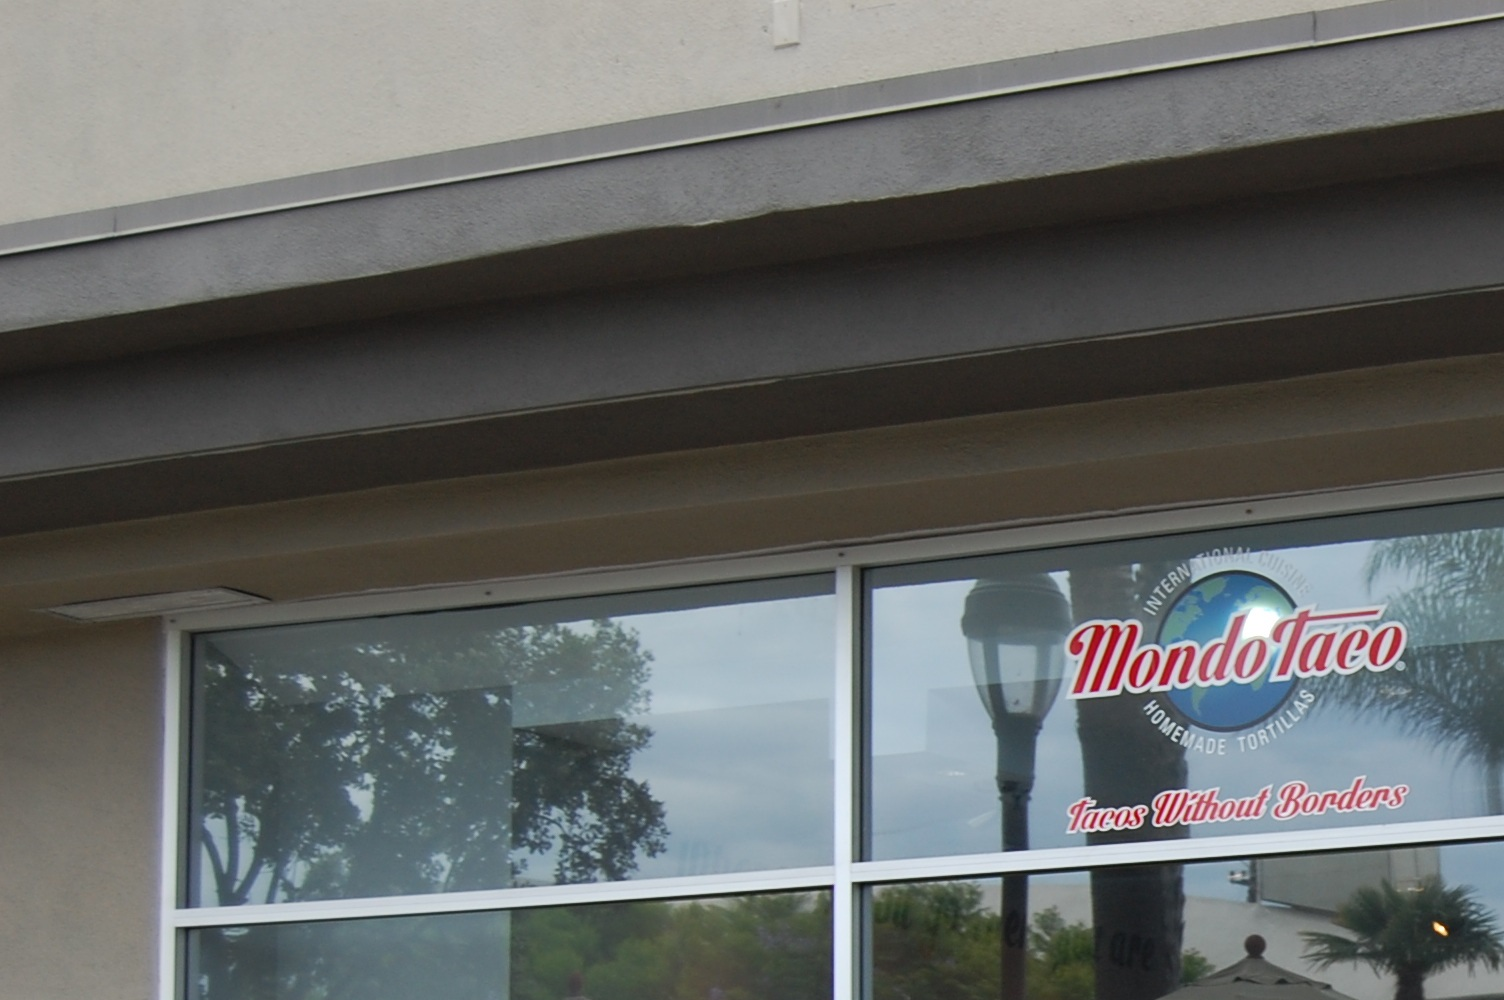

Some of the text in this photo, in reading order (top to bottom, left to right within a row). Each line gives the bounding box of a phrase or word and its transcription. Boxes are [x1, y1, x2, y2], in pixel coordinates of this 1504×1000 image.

[1143, 547, 1310, 616] INTERNATIONAL CUISINE
[1066, 606, 1406, 698] Mondo Taco
[1143, 689, 1315, 755] HOMEMADE TORTILLAS
[1066, 776, 1409, 833] Tacos Without Borders
